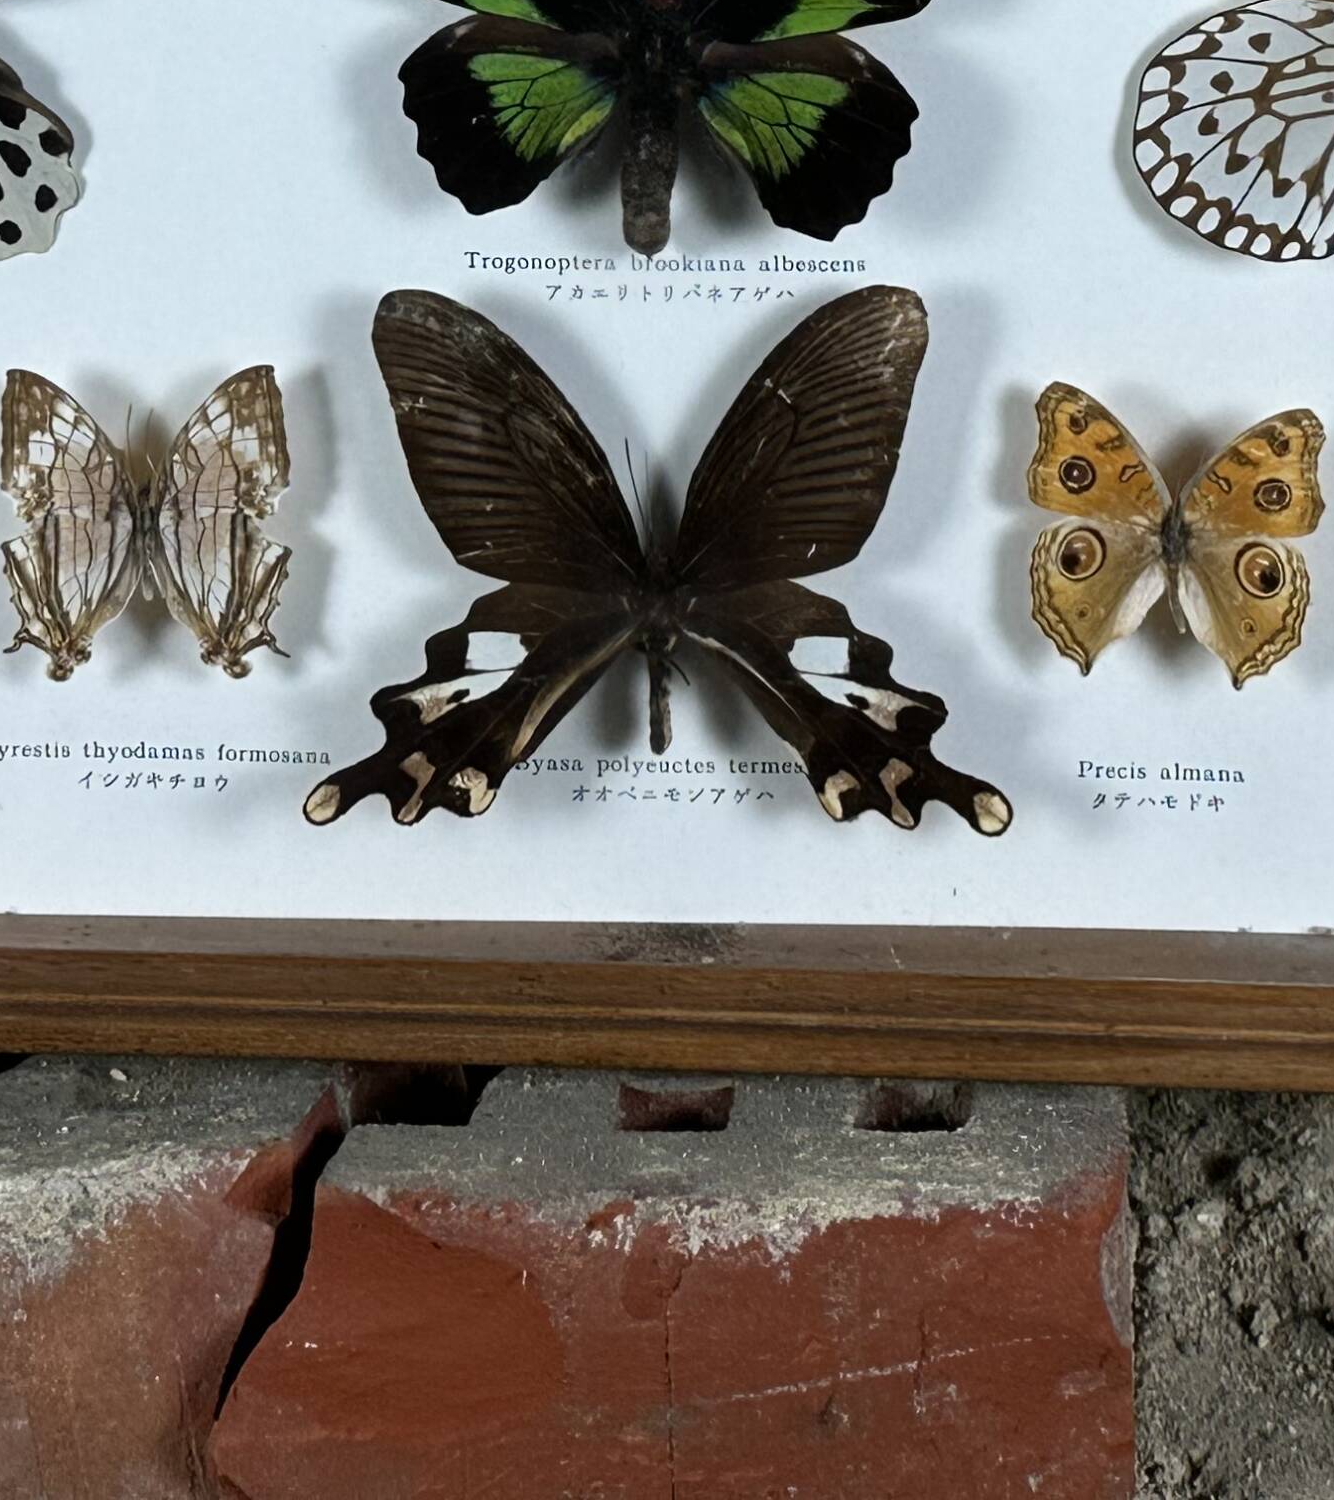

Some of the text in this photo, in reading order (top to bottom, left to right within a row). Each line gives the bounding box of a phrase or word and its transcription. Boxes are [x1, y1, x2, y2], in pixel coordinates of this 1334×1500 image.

[463, 251, 867, 275] Trogonoptera brookiana albescens
[82, 740, 206, 764] thyodamas
[216, 742, 331, 766] formosana
[596, 756, 716, 778] polyeuctes
[1077, 760, 1245, 783] Precis almana
